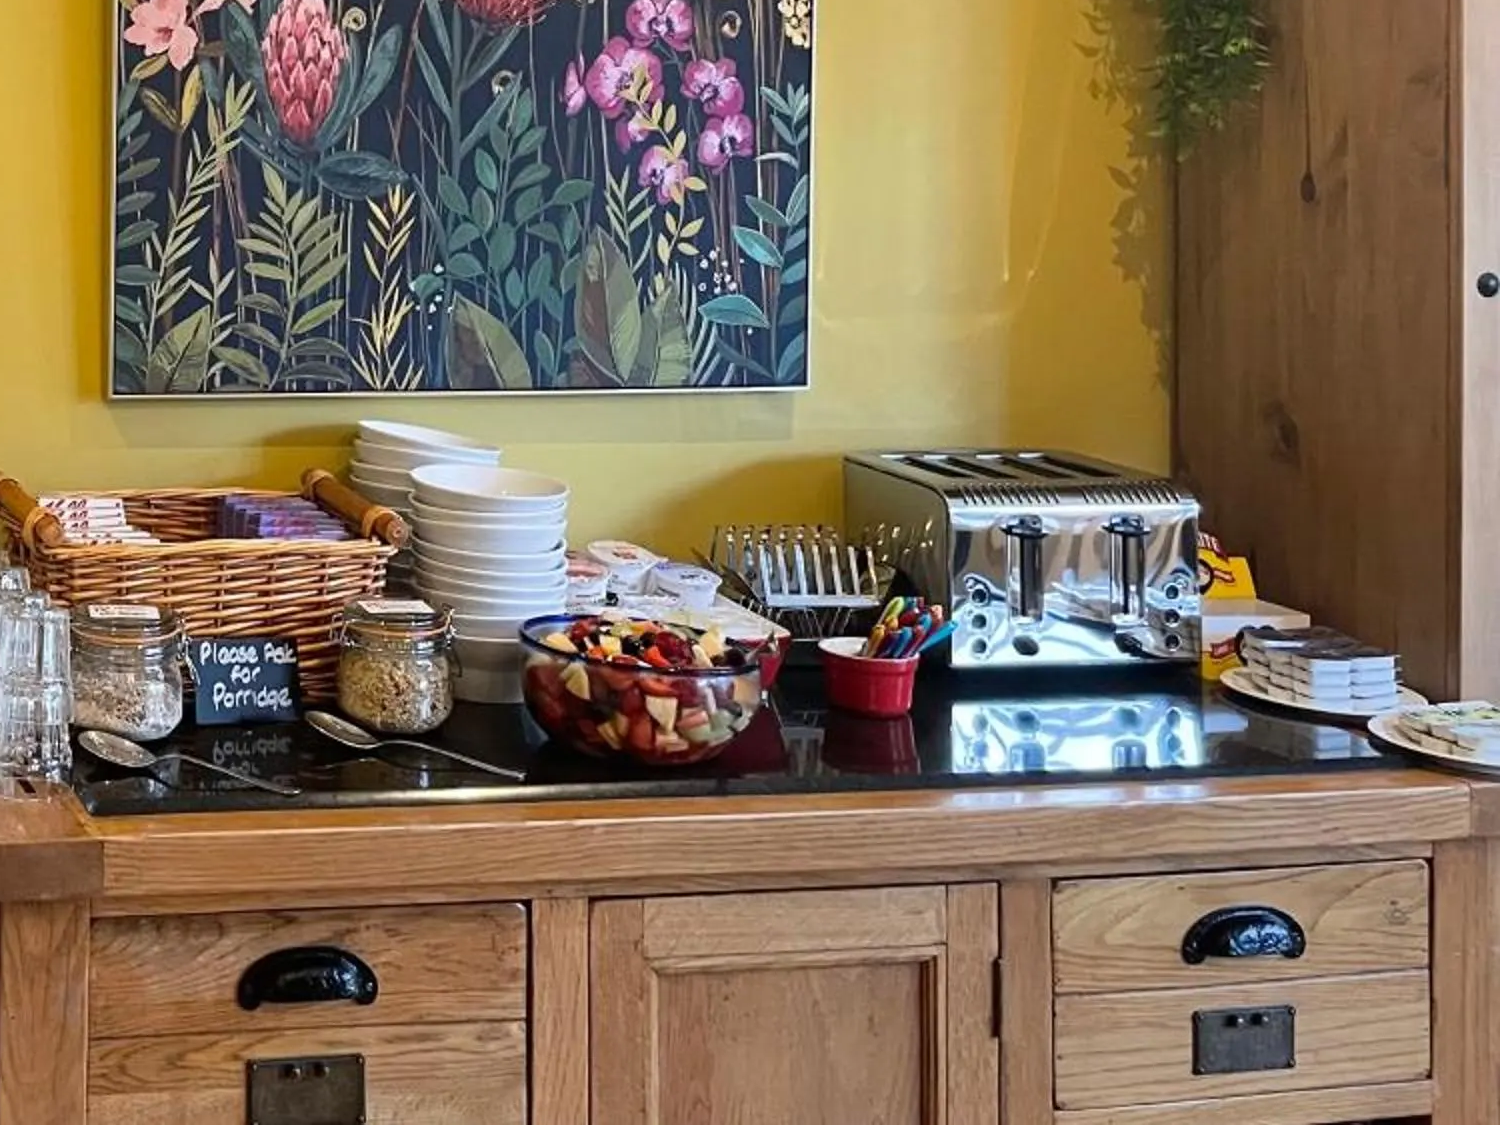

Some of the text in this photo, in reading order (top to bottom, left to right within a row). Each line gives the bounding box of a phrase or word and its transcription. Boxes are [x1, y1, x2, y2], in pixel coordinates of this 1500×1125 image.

[201, 641, 297, 666] Please Ask
[230, 664, 261, 684] for
[213, 682, 292, 711] Porridge
